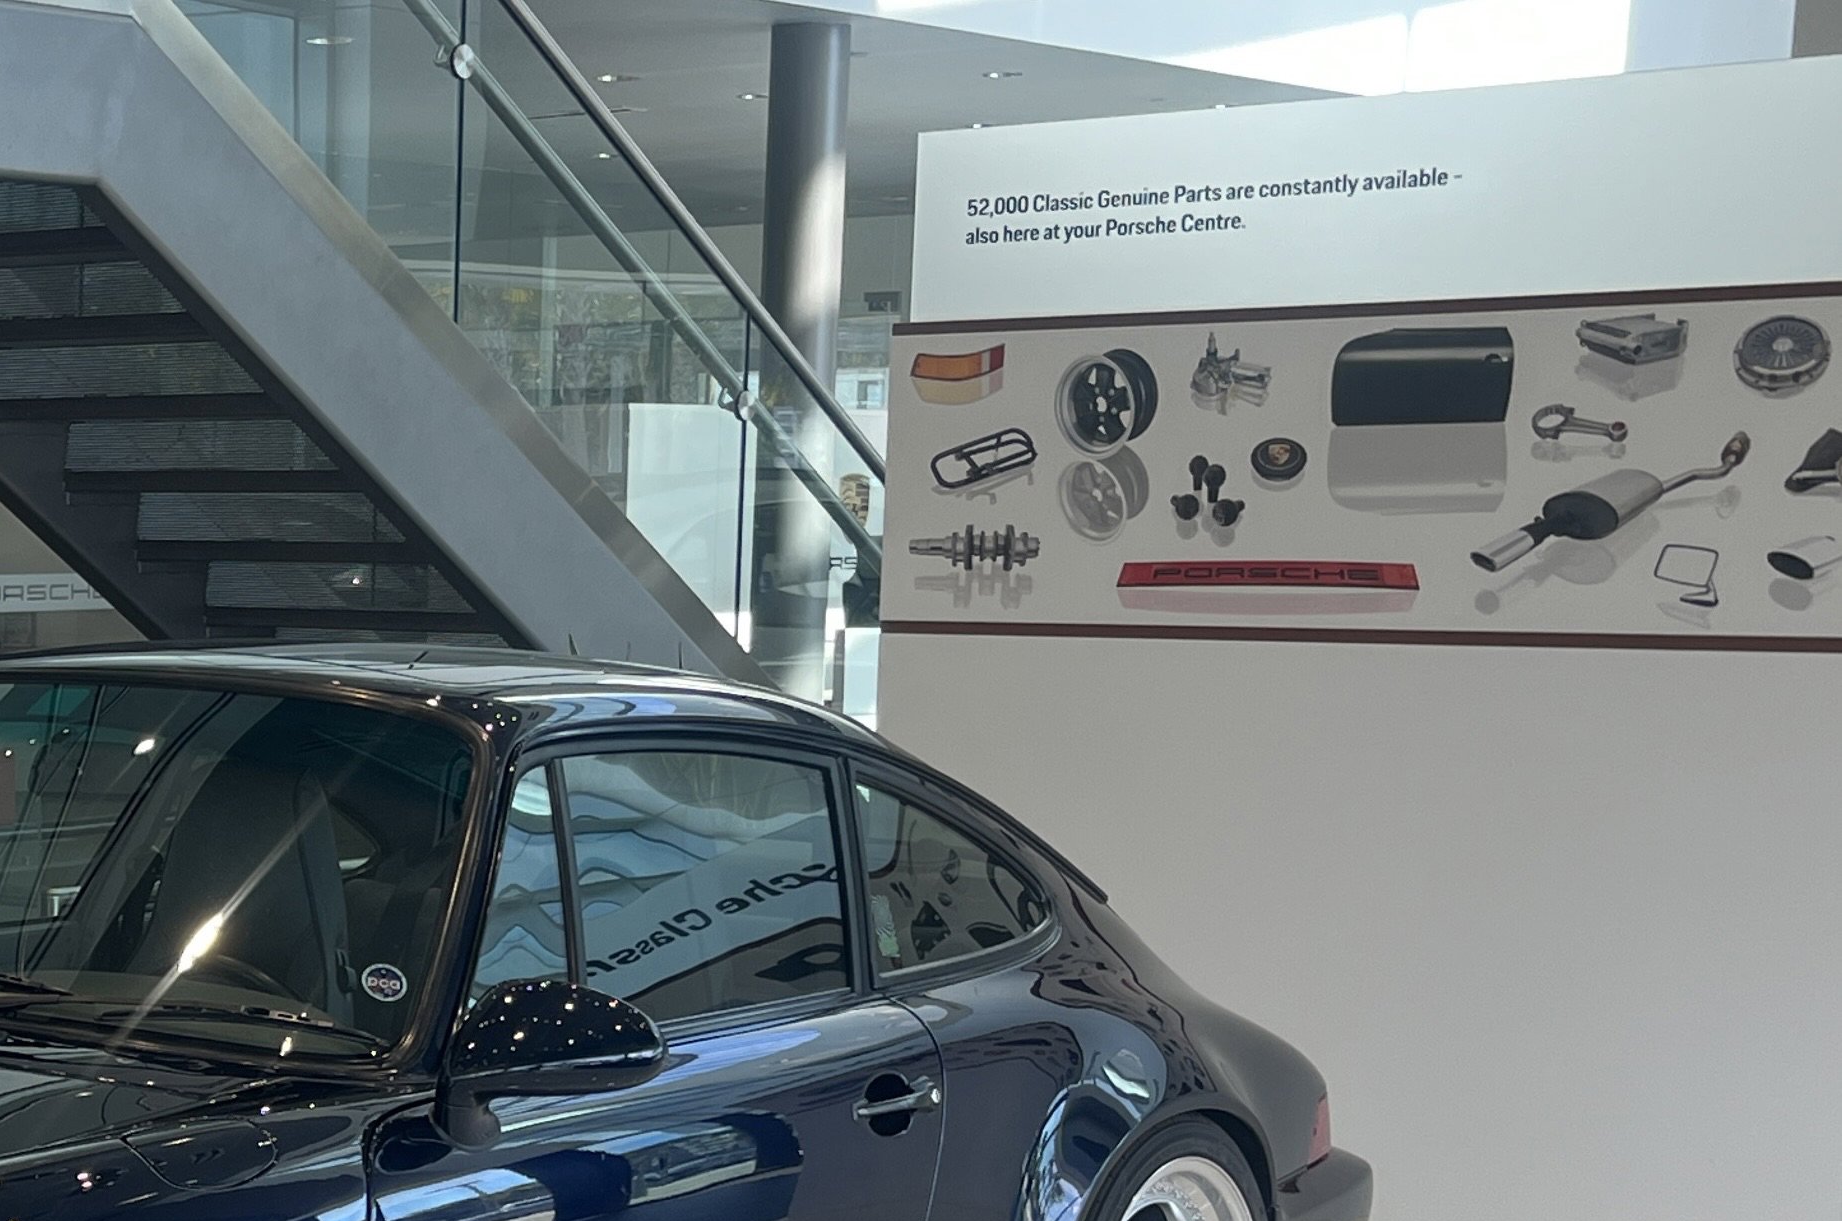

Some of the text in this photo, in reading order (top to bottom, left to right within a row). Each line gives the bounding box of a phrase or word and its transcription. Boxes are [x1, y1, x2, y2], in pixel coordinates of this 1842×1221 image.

[967, 195, 1029, 220] 52,000
[1033, 191, 1094, 213] Classic
[1097, 186, 1169, 210] Genuine
[1174, 183, 1222, 204] Parts
[1225, 185, 1254, 202] are
[1259, 173, 1359, 200] constantly
[1362, 166, 1448, 192] available
[965, 211, 1247, 246] also here at your Porsche Centre.
[1153, 567, 1382, 582] PORSCHE
